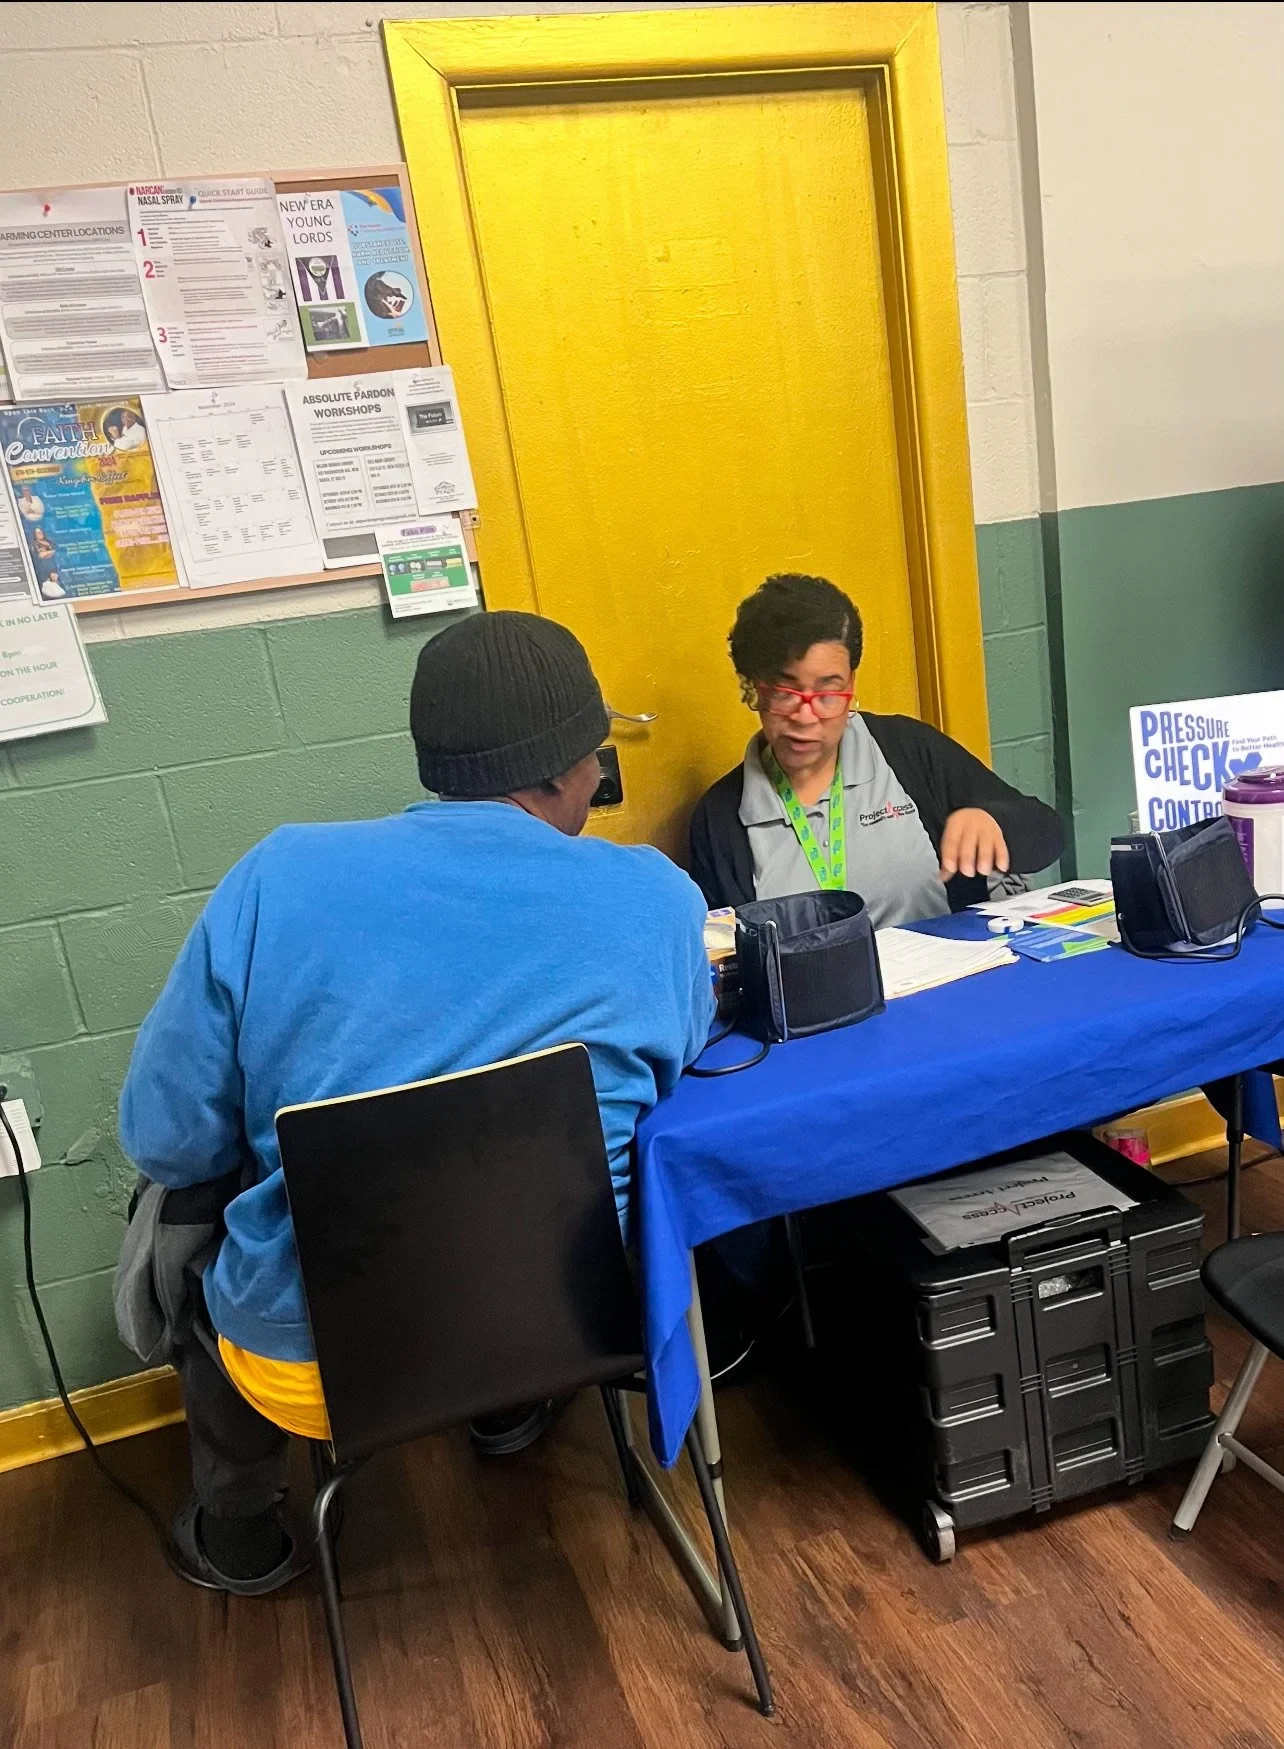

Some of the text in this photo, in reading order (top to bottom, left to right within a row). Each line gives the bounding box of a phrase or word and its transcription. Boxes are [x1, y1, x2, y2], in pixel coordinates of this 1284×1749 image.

[136, 185, 163, 195] NARCAN
[198, 187, 269, 197] QUICK START GUIDE
[138, 194, 184, 206] NASAL SPRAY
[280, 198, 334, 213] NEW ERA
[287, 214, 332, 229] YOUNG
[37, 228, 73, 239] CENTER
[73, 226, 125, 237] LOCATIONS
[137, 229, 147, 246] 1
[293, 231, 333, 245] LORDS
[143, 260, 155, 279] 2
[156, 327, 168, 343] 3
[302, 388, 395, 405] ABSOLUTE PARDON
[314, 403, 382, 419] WORKSHOPS
[31, 422, 99, 445] FAITH
[5, 441, 115, 466] Convention
[319, 443, 392, 456] UPCOMING WORKSHOPS
[6, 617, 16, 627] IN
[18, 616, 31, 625] NO
[34, 611, 60, 622] LATER
[0, 661, 58, 678] ON THE HOUR
[1, 688, 65, 706] COOPERATION!
[1140, 710, 1230, 747] PRESSURE
[1144, 740, 1231, 793] CHECK
[859, 806, 887, 822] Project
[1148, 797, 1223, 833] CONTRO
[1019, 1191, 1077, 1209] Project
